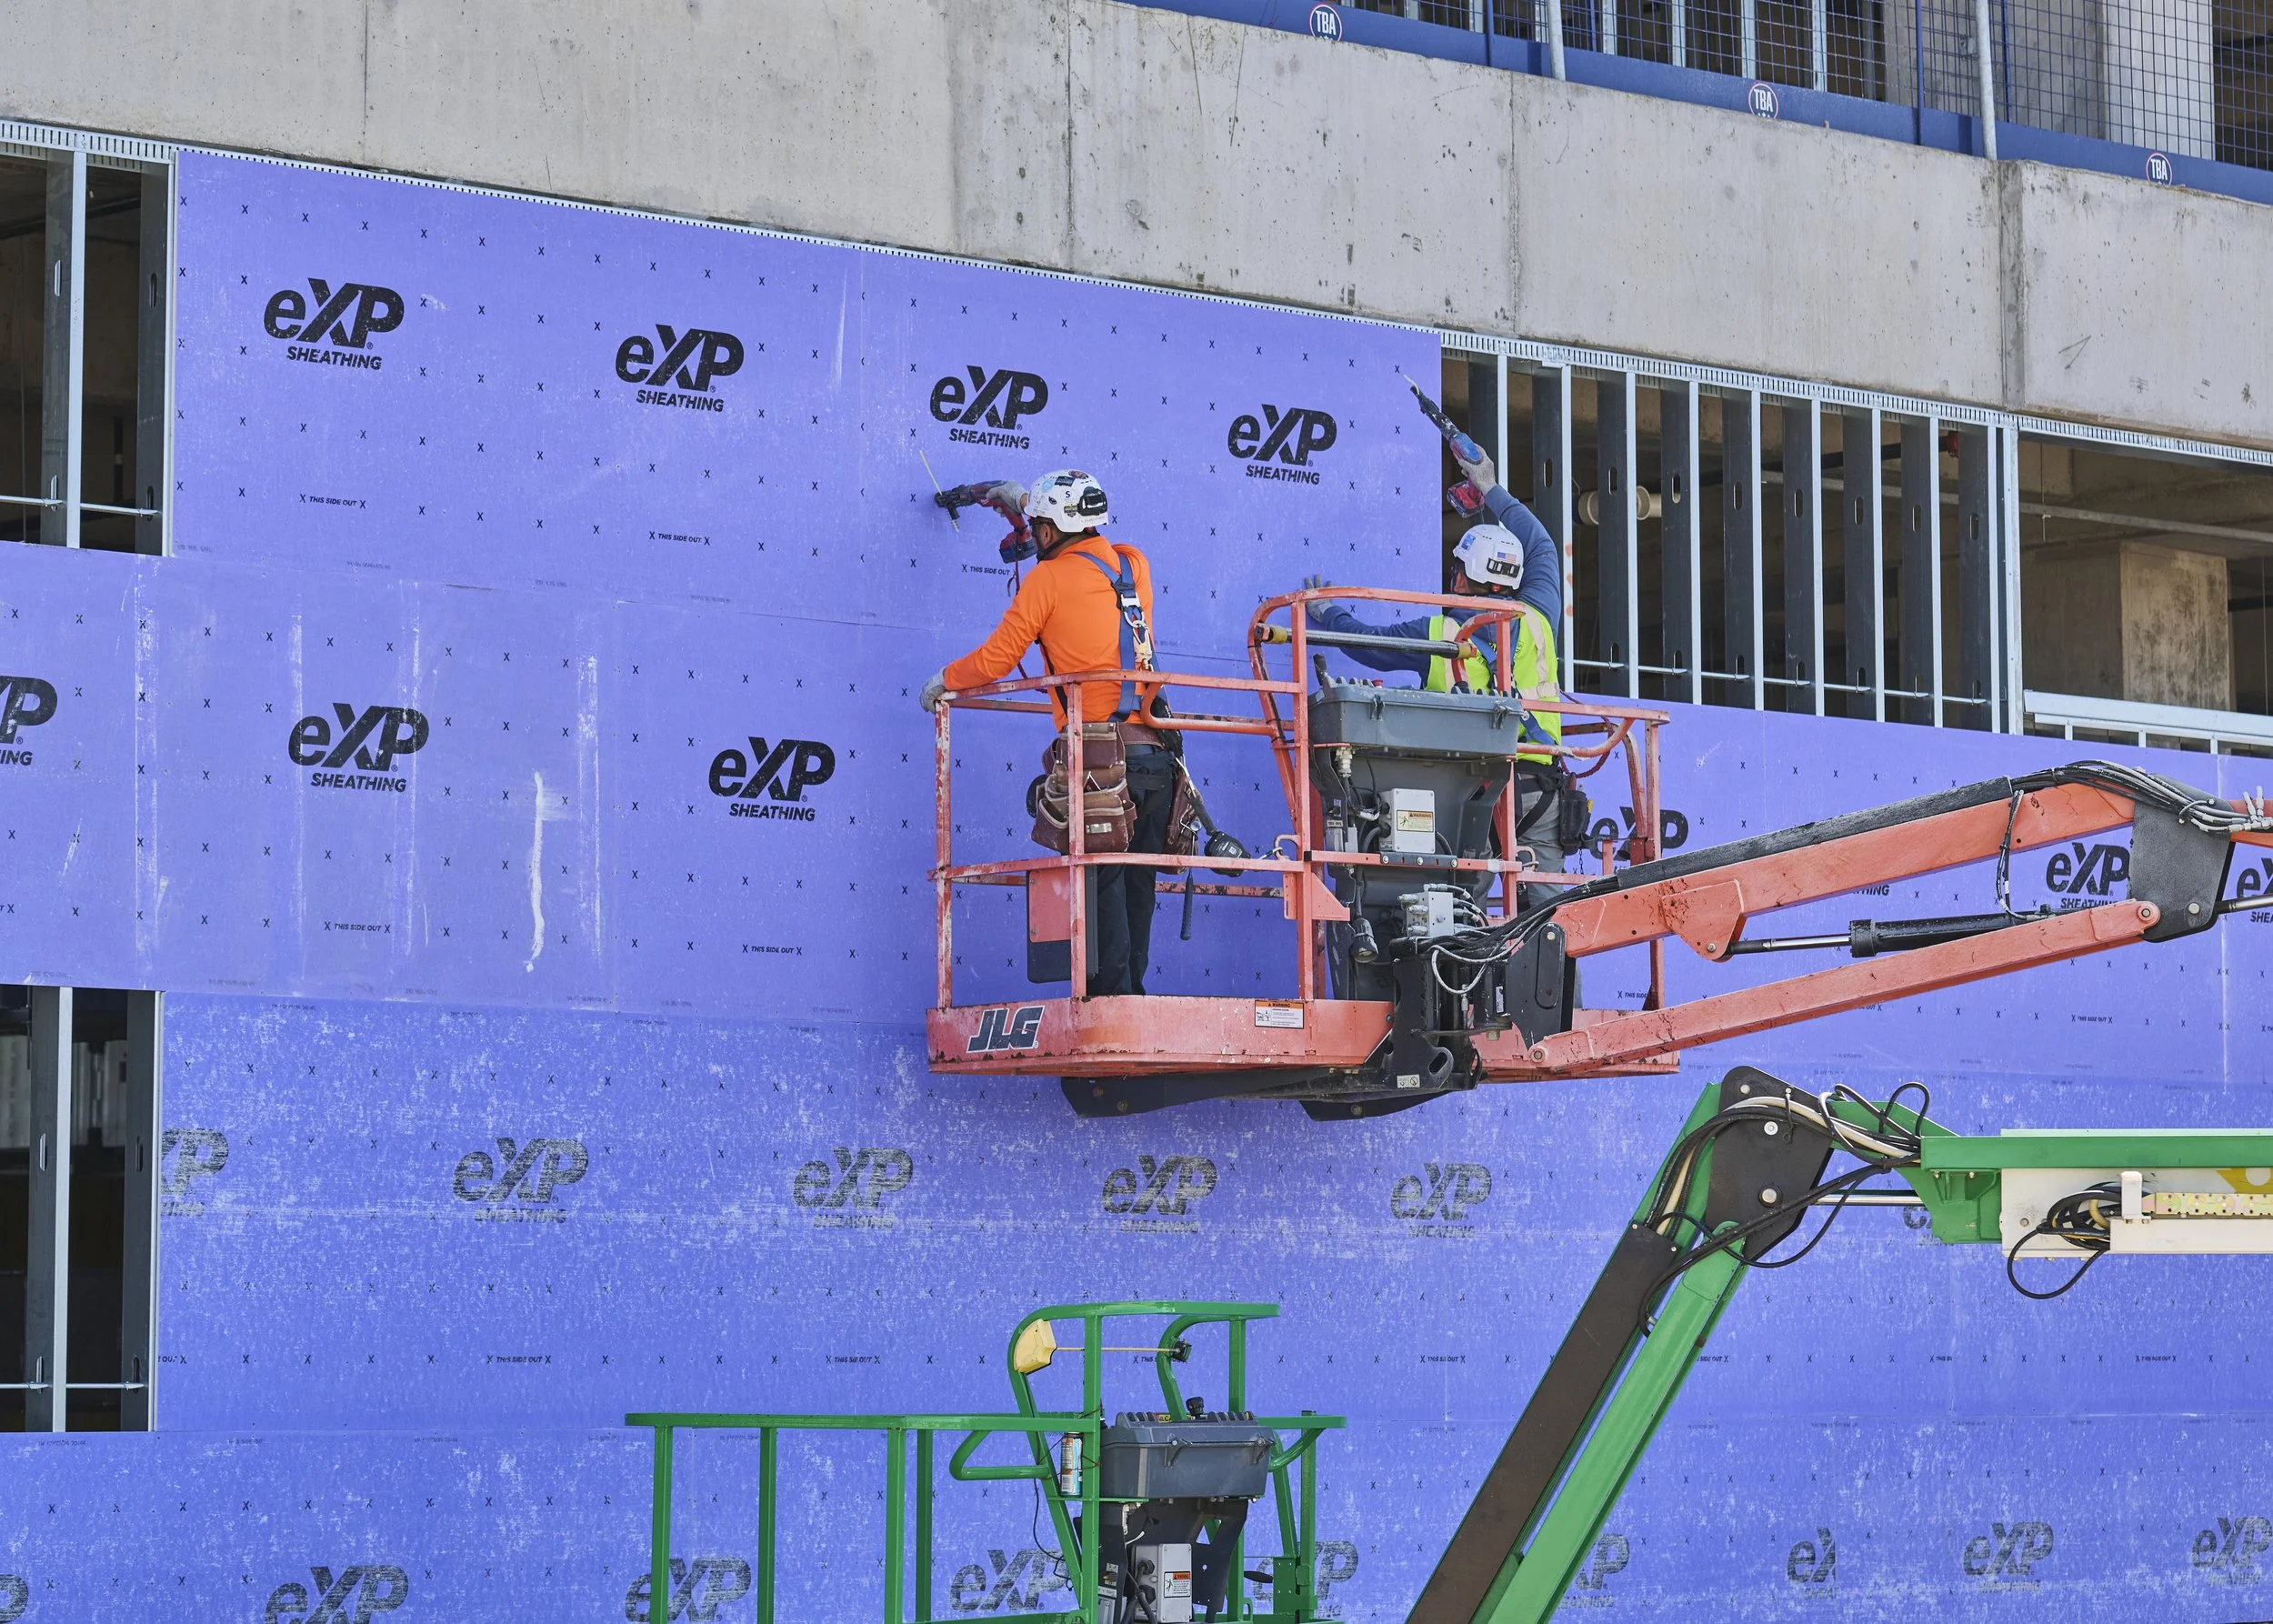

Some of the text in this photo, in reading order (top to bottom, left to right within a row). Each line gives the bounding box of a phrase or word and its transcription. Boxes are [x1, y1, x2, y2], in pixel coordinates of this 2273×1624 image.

[1316, 10, 1337, 35] TBA
[1754, 88, 1773, 113] TBA
[2150, 158, 2168, 181] TBA
[264, 277, 405, 349] eXP
[286, 346, 382, 370] SHEATHING
[616, 324, 745, 392] eXP
[636, 389, 724, 412] SHEATHING
[930, 365, 1048, 430] eXP
[949, 428, 1030, 449] SHEATHING
[1227, 404, 1337, 466] eXP
[1246, 465, 1320, 485] SHEATHING
[309, 496, 325, 504] THIS
[288, 702, 429, 771] eXP
[708, 736, 836, 801] eXP
[310, 772, 406, 793] SHEATHING
[729, 803, 816, 822] SHEATHING
[966, 1005, 1046, 1053] JLG
[453, 1137, 588, 1203] eXP
